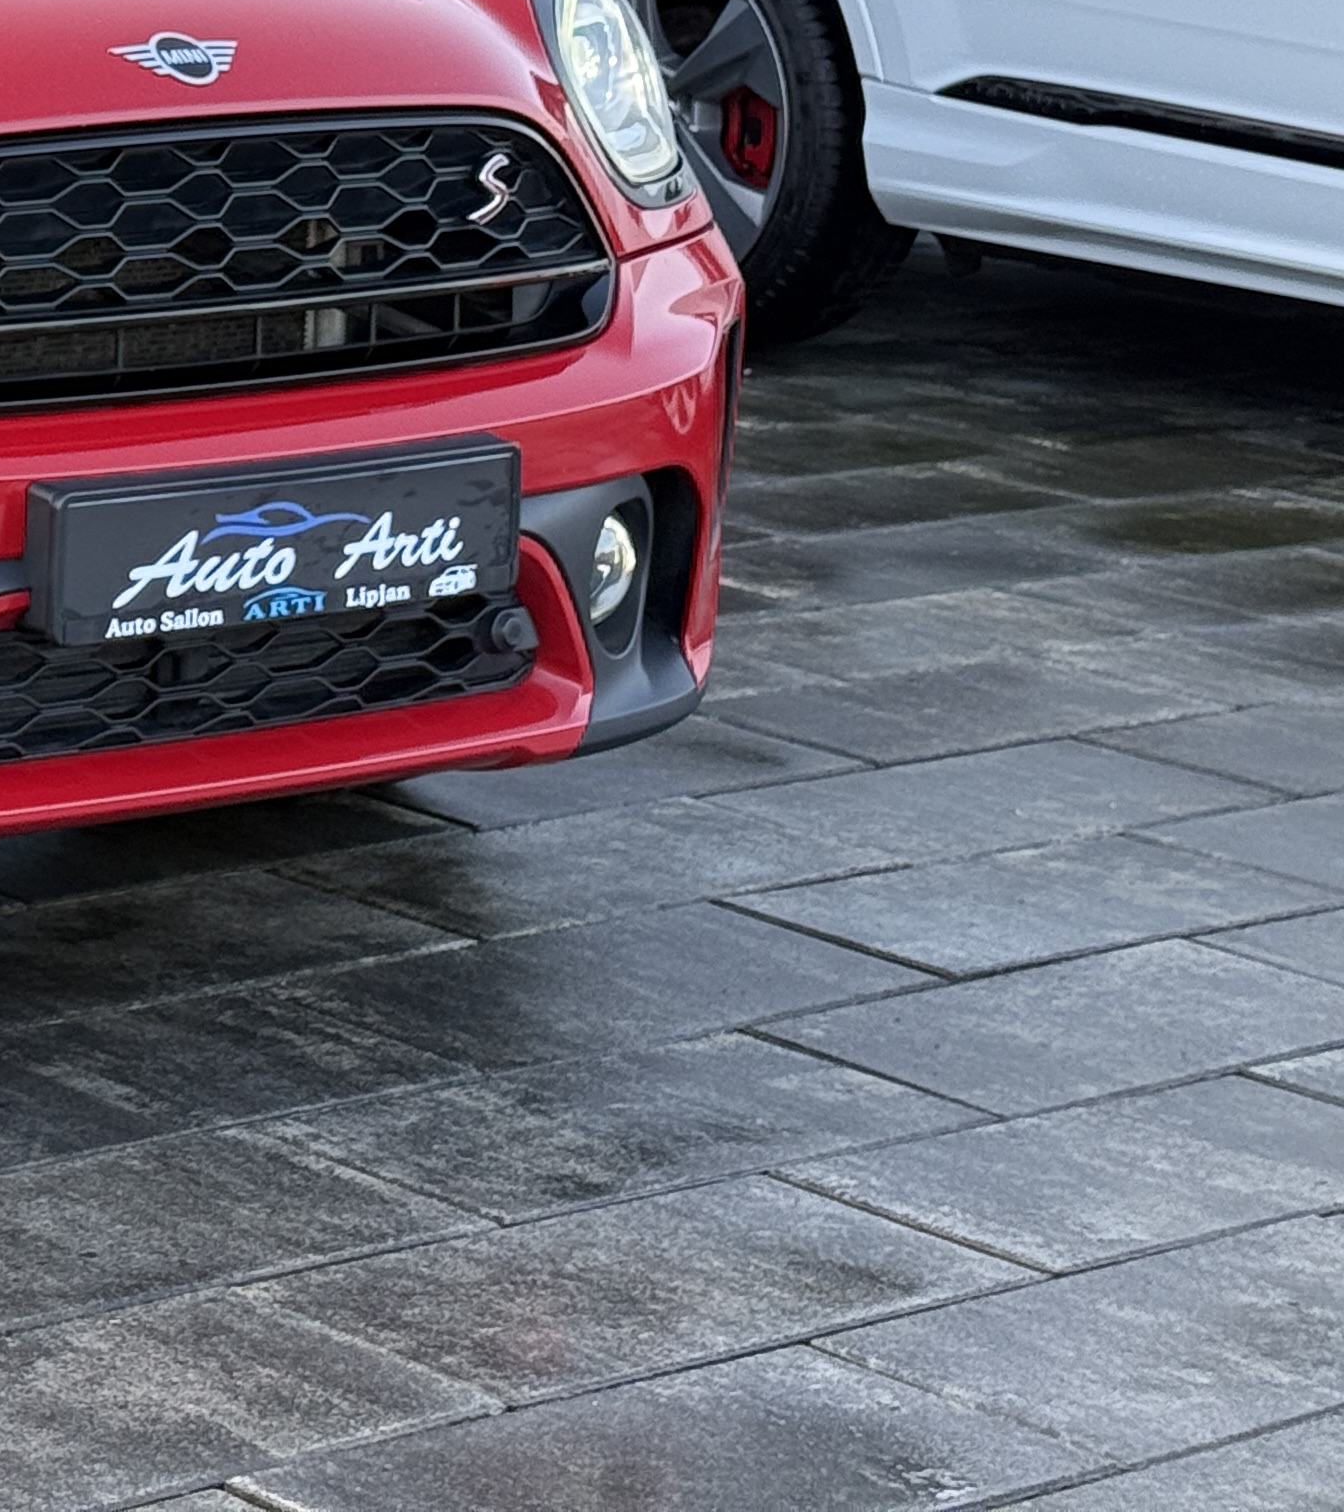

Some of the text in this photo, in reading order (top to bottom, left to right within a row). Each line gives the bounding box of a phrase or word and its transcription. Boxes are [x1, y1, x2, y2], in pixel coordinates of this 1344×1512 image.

[159, 47, 210, 65] MINI
[466, 153, 510, 226] S
[112, 510, 463, 610] Auto Arti
[244, 593, 326, 622] ARTI
[345, 584, 411, 608] Lipjan
[105, 607, 224, 638] Auto Sallon
